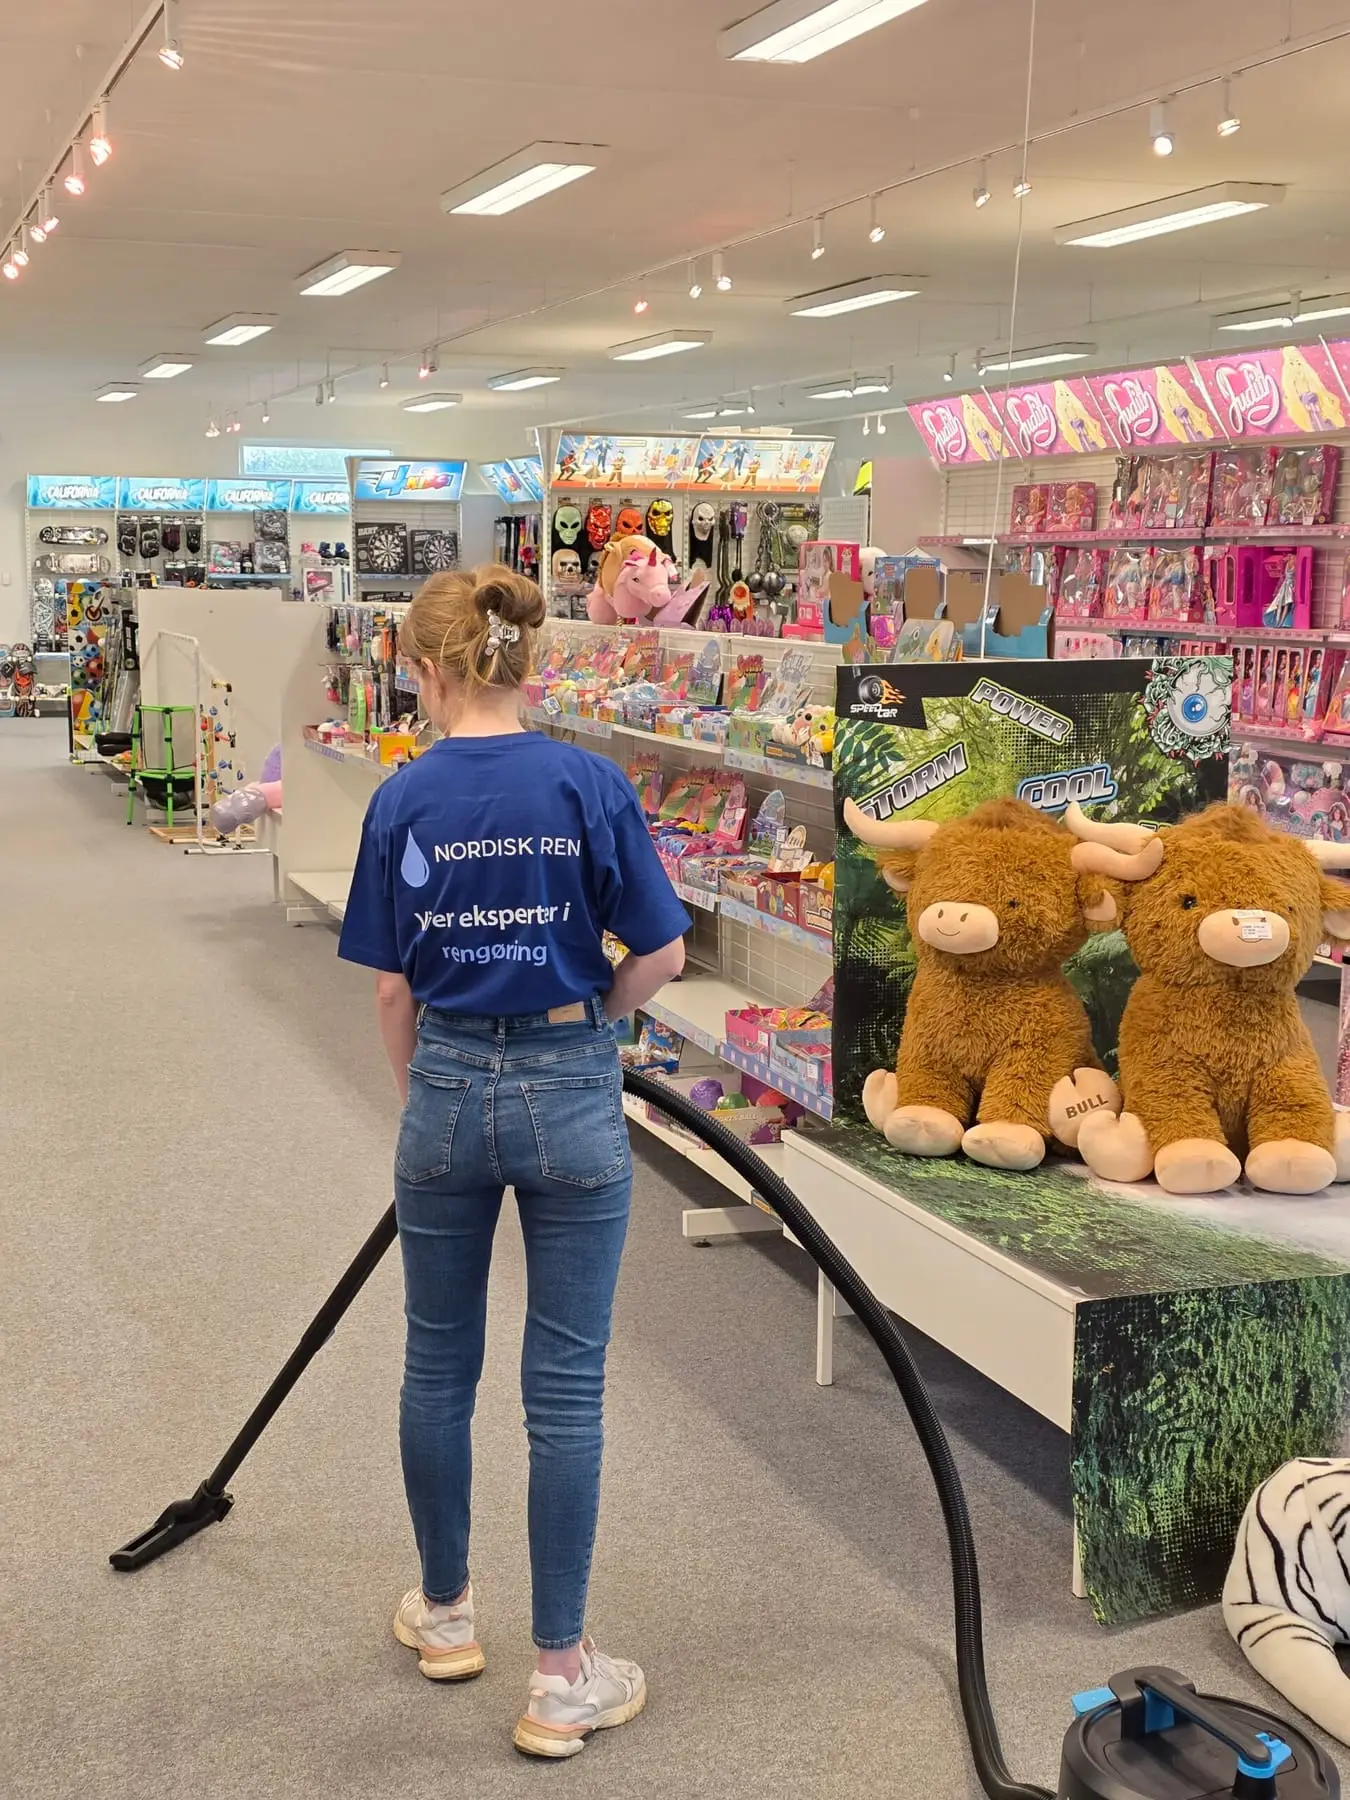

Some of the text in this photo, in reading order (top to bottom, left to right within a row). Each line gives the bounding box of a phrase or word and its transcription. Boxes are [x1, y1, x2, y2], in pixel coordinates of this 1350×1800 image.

[1103, 377, 1159, 444] Judith
[1214, 359, 1280, 434] Judith
[922, 405, 967, 463] Judith
[1006, 391, 1057, 454] Judith
[46, 485, 99, 499] CALIFORNIA
[136, 487, 189, 501] CALIFORNIA
[224, 488, 274, 504] CALIFORNIA
[850, 703, 882, 713] SPEED
[971, 680, 1071, 742] POWER
[1020, 767, 1115, 811] COOL
[434, 837, 581, 863] NORDISK REN
[431, 911, 456, 928] er
[459, 904, 559, 931] eksperter
[562, 901, 572, 922] i
[442, 939, 548, 967] rengøring
[1065, 1093, 1109, 1119] BULL
